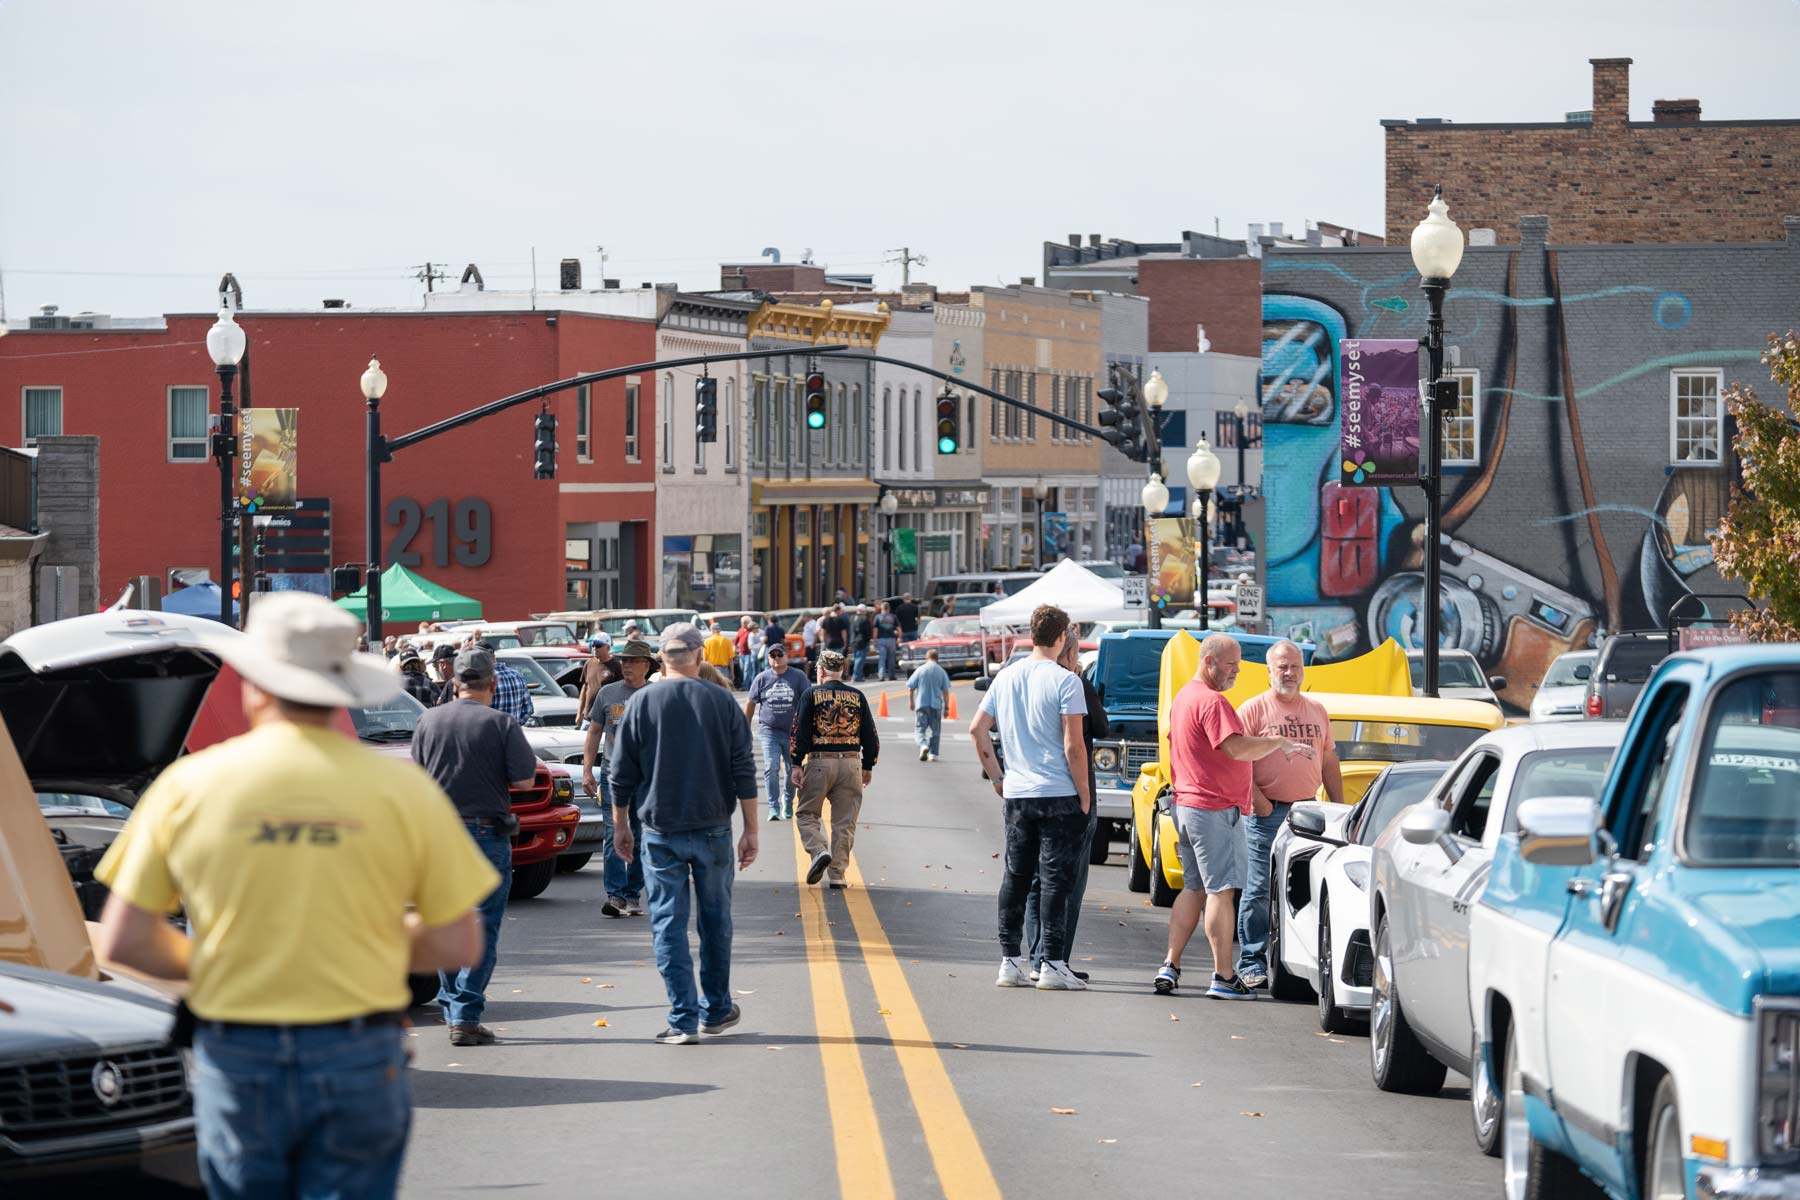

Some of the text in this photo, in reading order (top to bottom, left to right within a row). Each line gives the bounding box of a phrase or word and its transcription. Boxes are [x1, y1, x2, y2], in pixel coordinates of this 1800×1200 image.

[1345, 341, 1364, 448] #seemyset
[241, 408, 255, 487] #seemyset
[386, 496, 492, 568] 219
[1126, 578, 1144, 588] ONE
[1126, 588, 1144, 596] WAY
[1239, 588, 1259, 598] ONE
[1239, 598, 1259, 608] WAY
[1452, 900, 1469, 916] R/T
